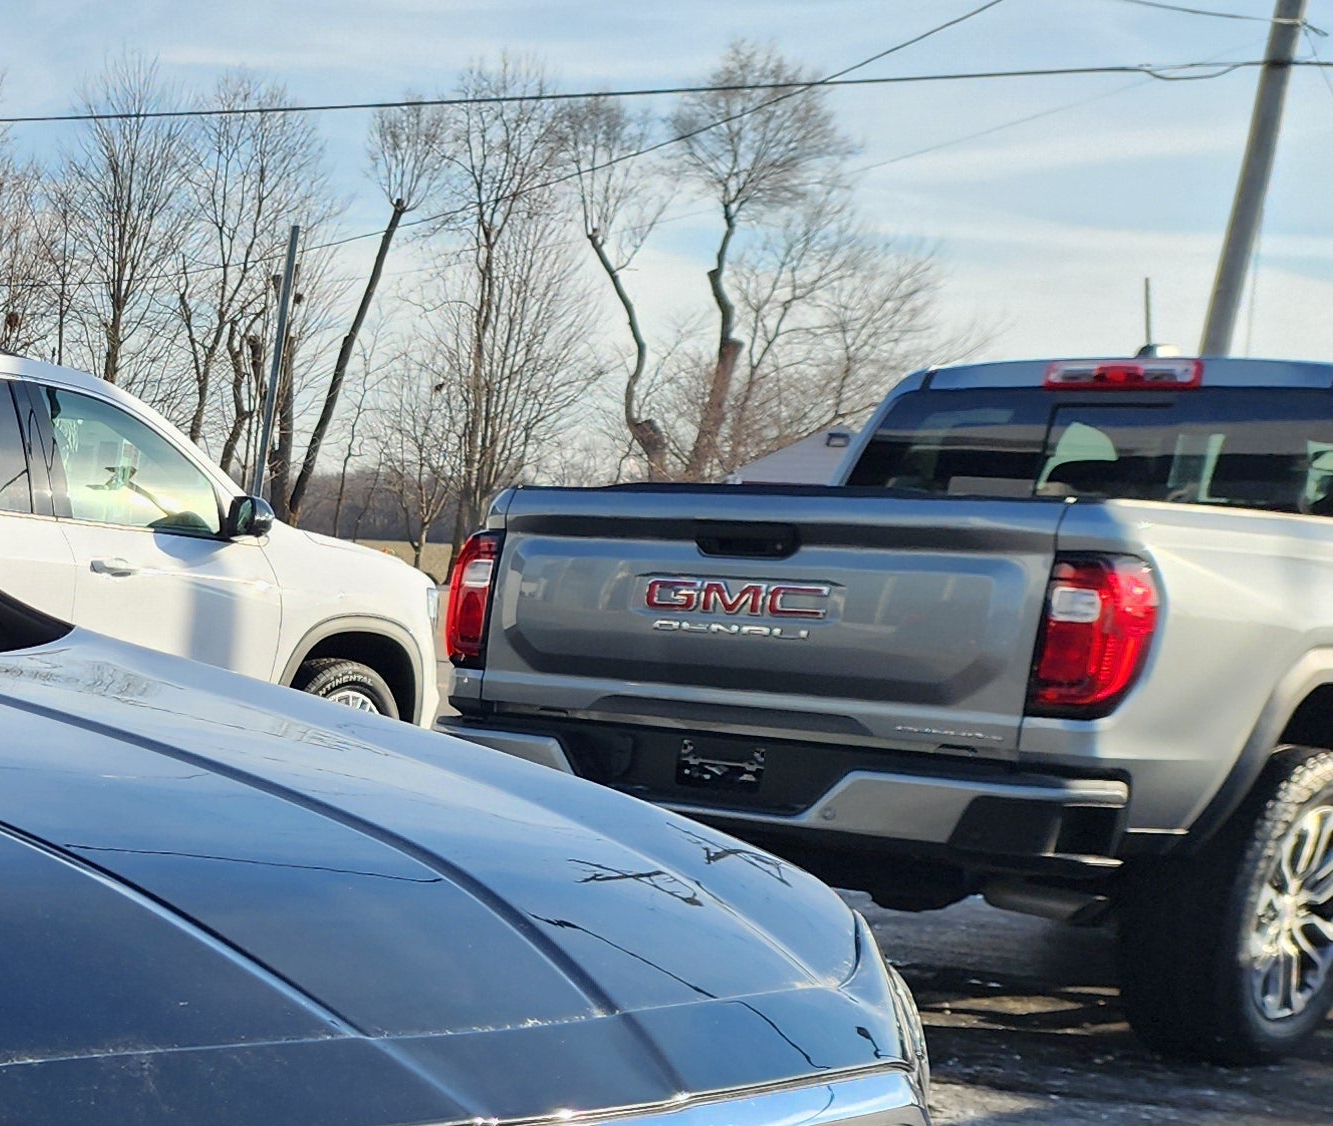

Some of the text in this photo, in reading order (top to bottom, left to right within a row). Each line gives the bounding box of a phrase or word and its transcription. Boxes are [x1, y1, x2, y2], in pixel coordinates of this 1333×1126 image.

[645, 577, 830, 619] GMC
[651, 618, 809, 641] DENALI
[318, 673, 374, 697] NTINENTAL
